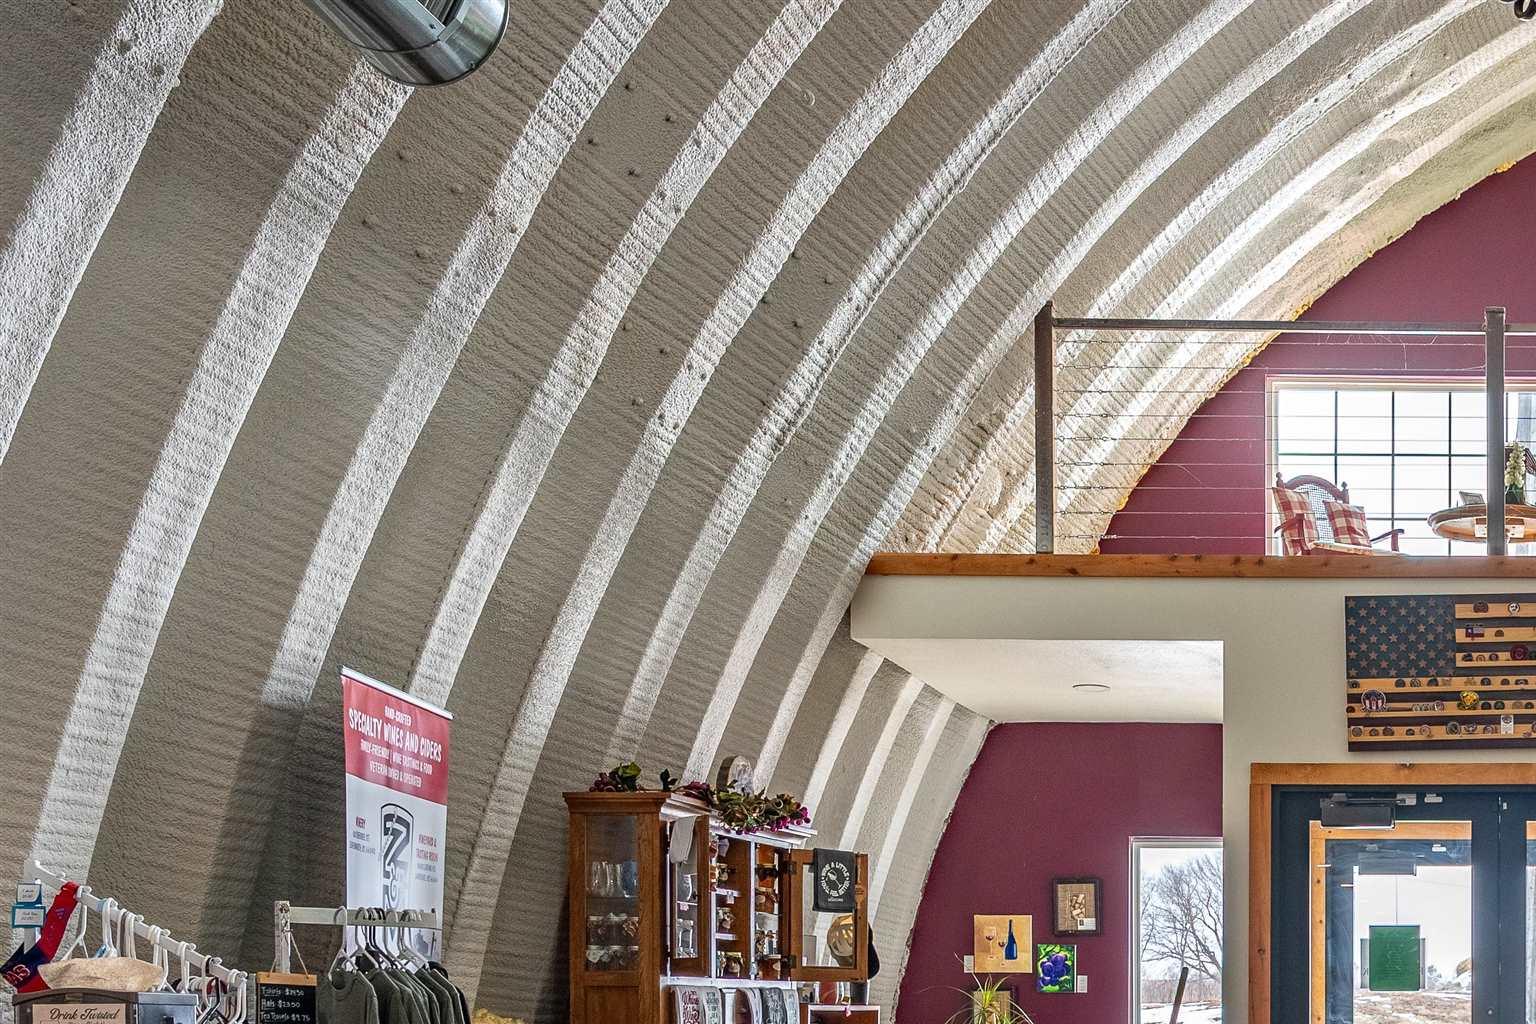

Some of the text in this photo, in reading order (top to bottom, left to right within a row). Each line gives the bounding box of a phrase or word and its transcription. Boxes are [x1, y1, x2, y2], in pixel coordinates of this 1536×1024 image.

[349, 708, 443, 763] SPECIALTY WINES AND CIDERS
[49, 1007, 121, 1021] Drink Twisted
